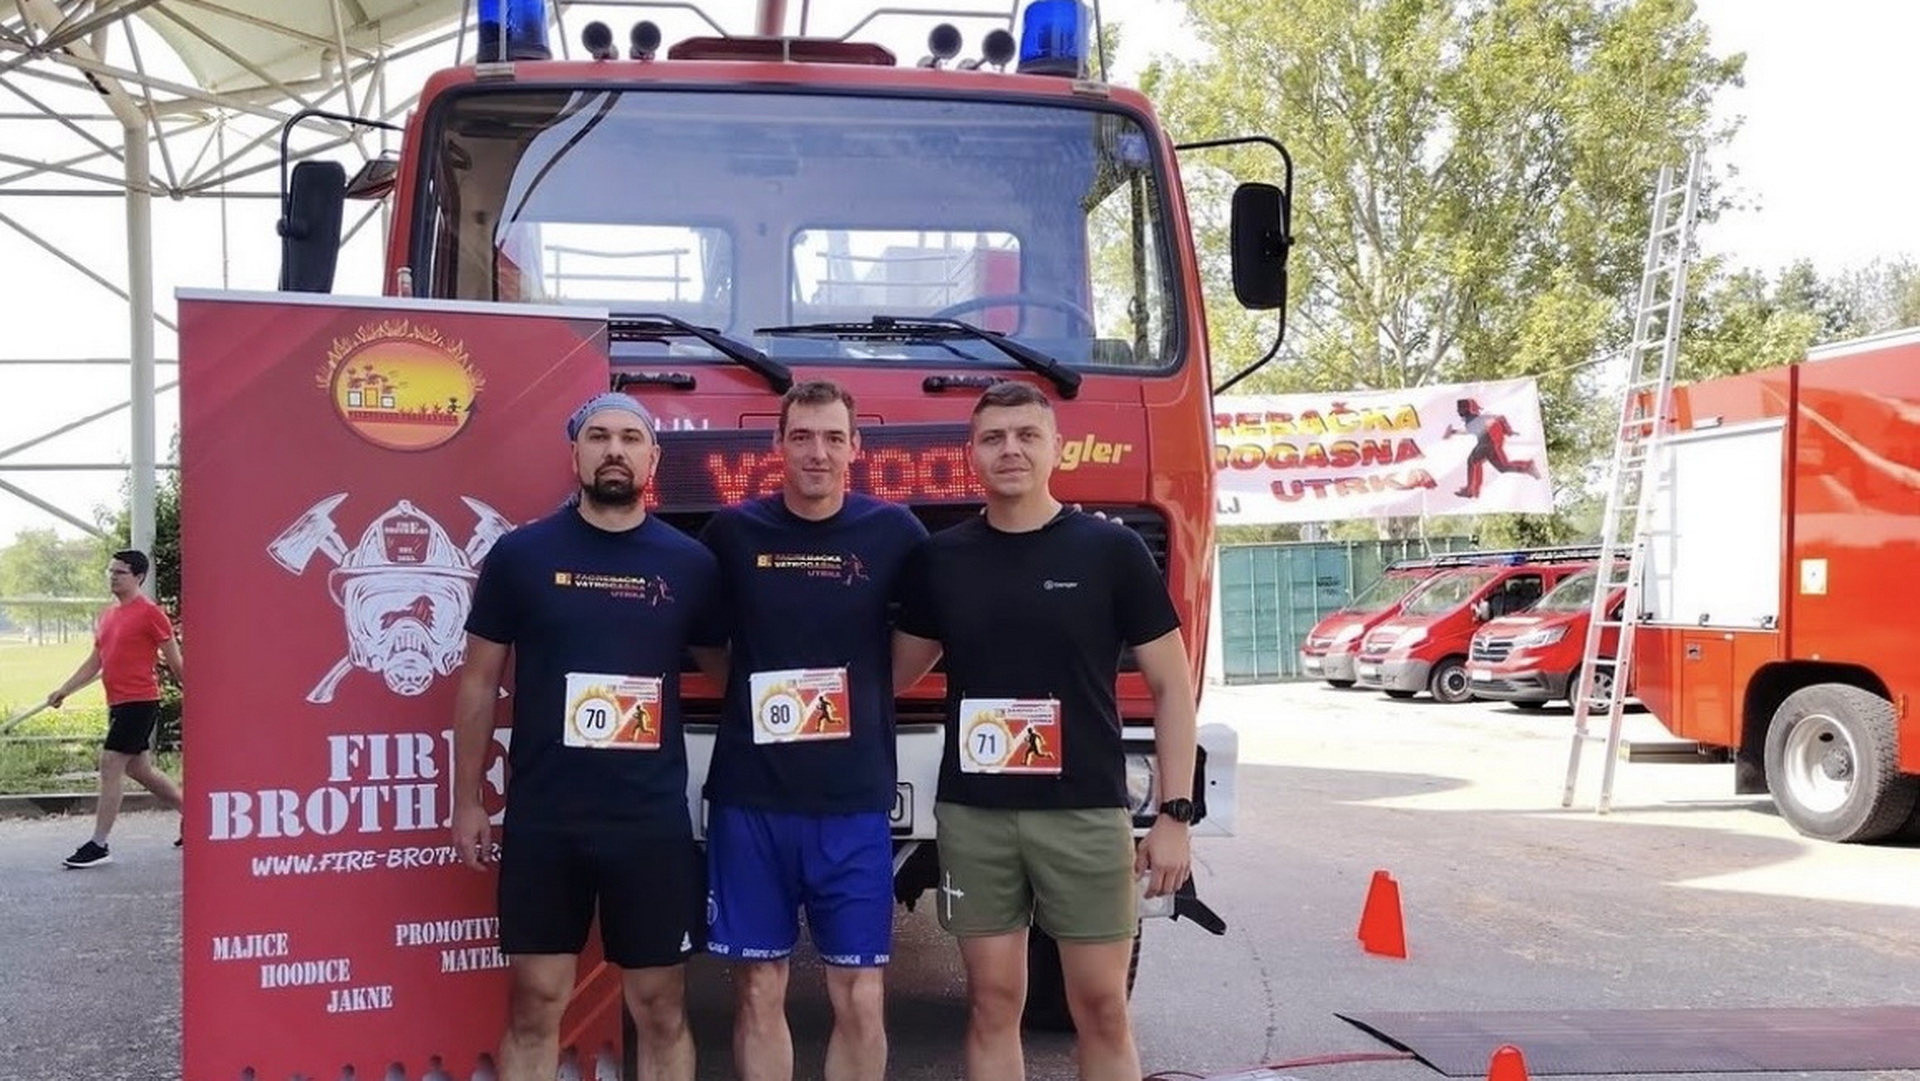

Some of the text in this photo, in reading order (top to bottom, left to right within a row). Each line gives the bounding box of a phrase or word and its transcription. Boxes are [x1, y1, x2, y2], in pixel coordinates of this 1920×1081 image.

[1271, 468, 1438, 503] UTRKA
[585, 708, 607, 730] 70
[770, 703, 791, 725] 80
[976, 732, 997, 755] 71
[212, 932, 289, 961] MAJICE
[260, 958, 351, 988] HOODICE
[326, 985, 393, 1013] JAKNE
